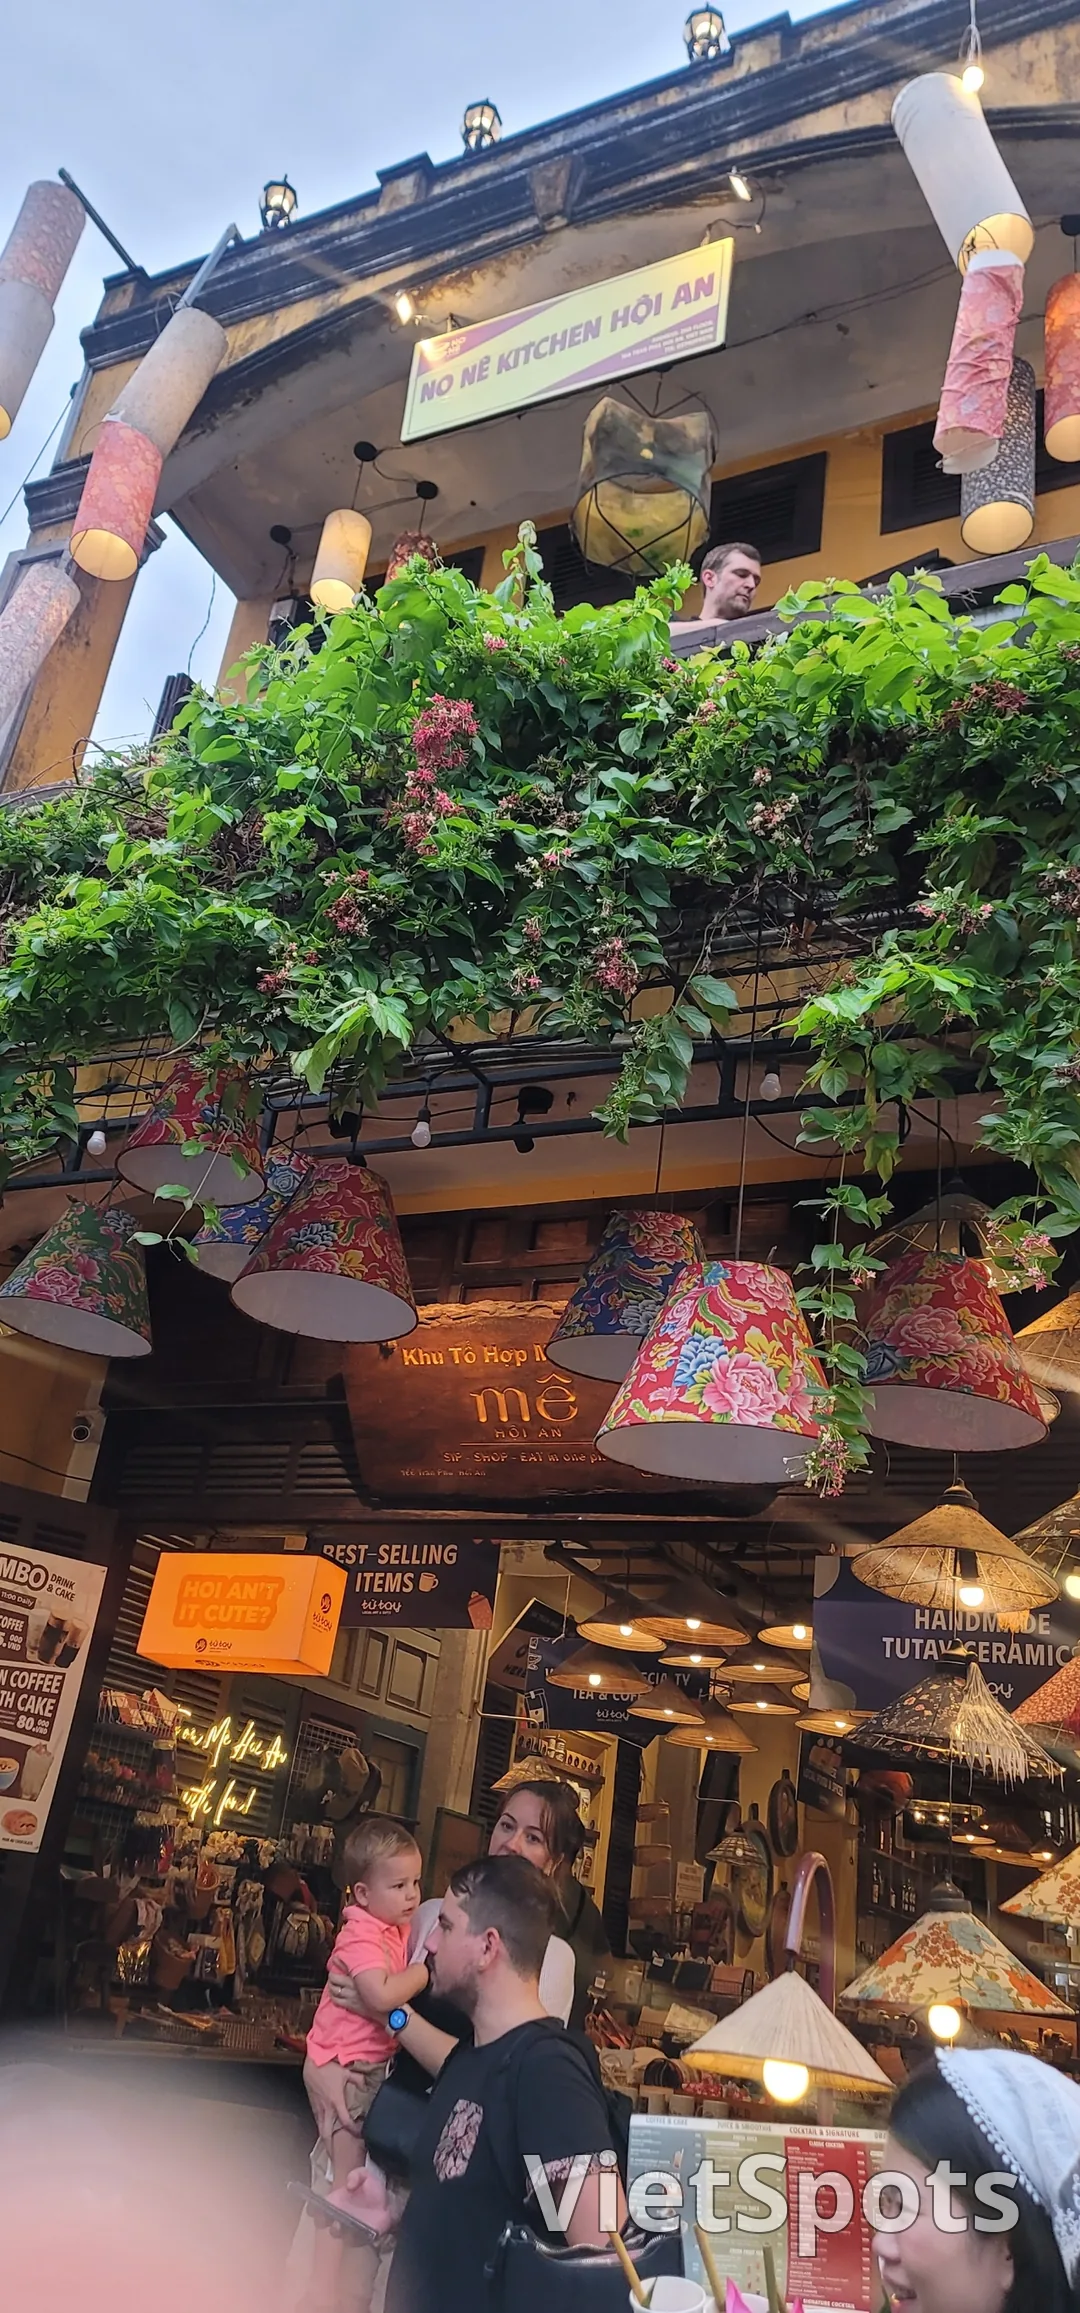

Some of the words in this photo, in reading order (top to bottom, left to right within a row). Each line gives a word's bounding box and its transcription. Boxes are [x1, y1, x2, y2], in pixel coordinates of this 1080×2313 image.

[420, 374, 453, 403] NO
[460, 355, 490, 388] NÊ
[496, 316, 602, 375] KITCHEN
[611, 293, 662, 331] HỘI
[671, 273, 715, 310] AN
[402, 1348, 444, 1366] Khu
[448, 1340, 477, 1364] Tổ
[483, 1344, 528, 1367] Hợp
[469, 1373, 579, 1424] mê
[494, 1425, 527, 1440] HỘI
[538, 1428, 562, 1438] AN
[443, 1452, 462, 1462] SIP
[473, 1452, 508, 1462] SHOP
[520, 1452, 544, 1462] EAT
[563, 1453, 586, 1462] one
[50, 1573, 76, 1590] DRINK
[183, 1581, 222, 1599] HOI
[226, 1581, 279, 1600] AN'T
[355, 1572, 414, 1593] ITEMS
[17, 1596, 34, 1607] Daily
[46, 1584, 54, 1593] &
[54, 1587, 76, 1602] CAKE
[179, 1603, 199, 1621] IT
[204, 1604, 271, 1624] CUTE?
[914, 1608, 1050, 1635] HANDMDE
[7, 1641, 21, 1651] VND
[9, 1634, 23, 1643] 000
[963, 1640, 1078, 1667] CERAMIC
[10, 1670, 63, 1694] COFFEE
[17, 1694, 57, 1718] CAKE
[37, 1719, 50, 1728] 000
[717, 2121, 734, 2129] JUICE
[789, 2126, 818, 2136] COCKTAIL
[825, 2129, 860, 2138] SIGNATURE
[803, 2298, 830, 2307] SIGNATURE
[831, 2300, 855, 2309] COCKTAIL
